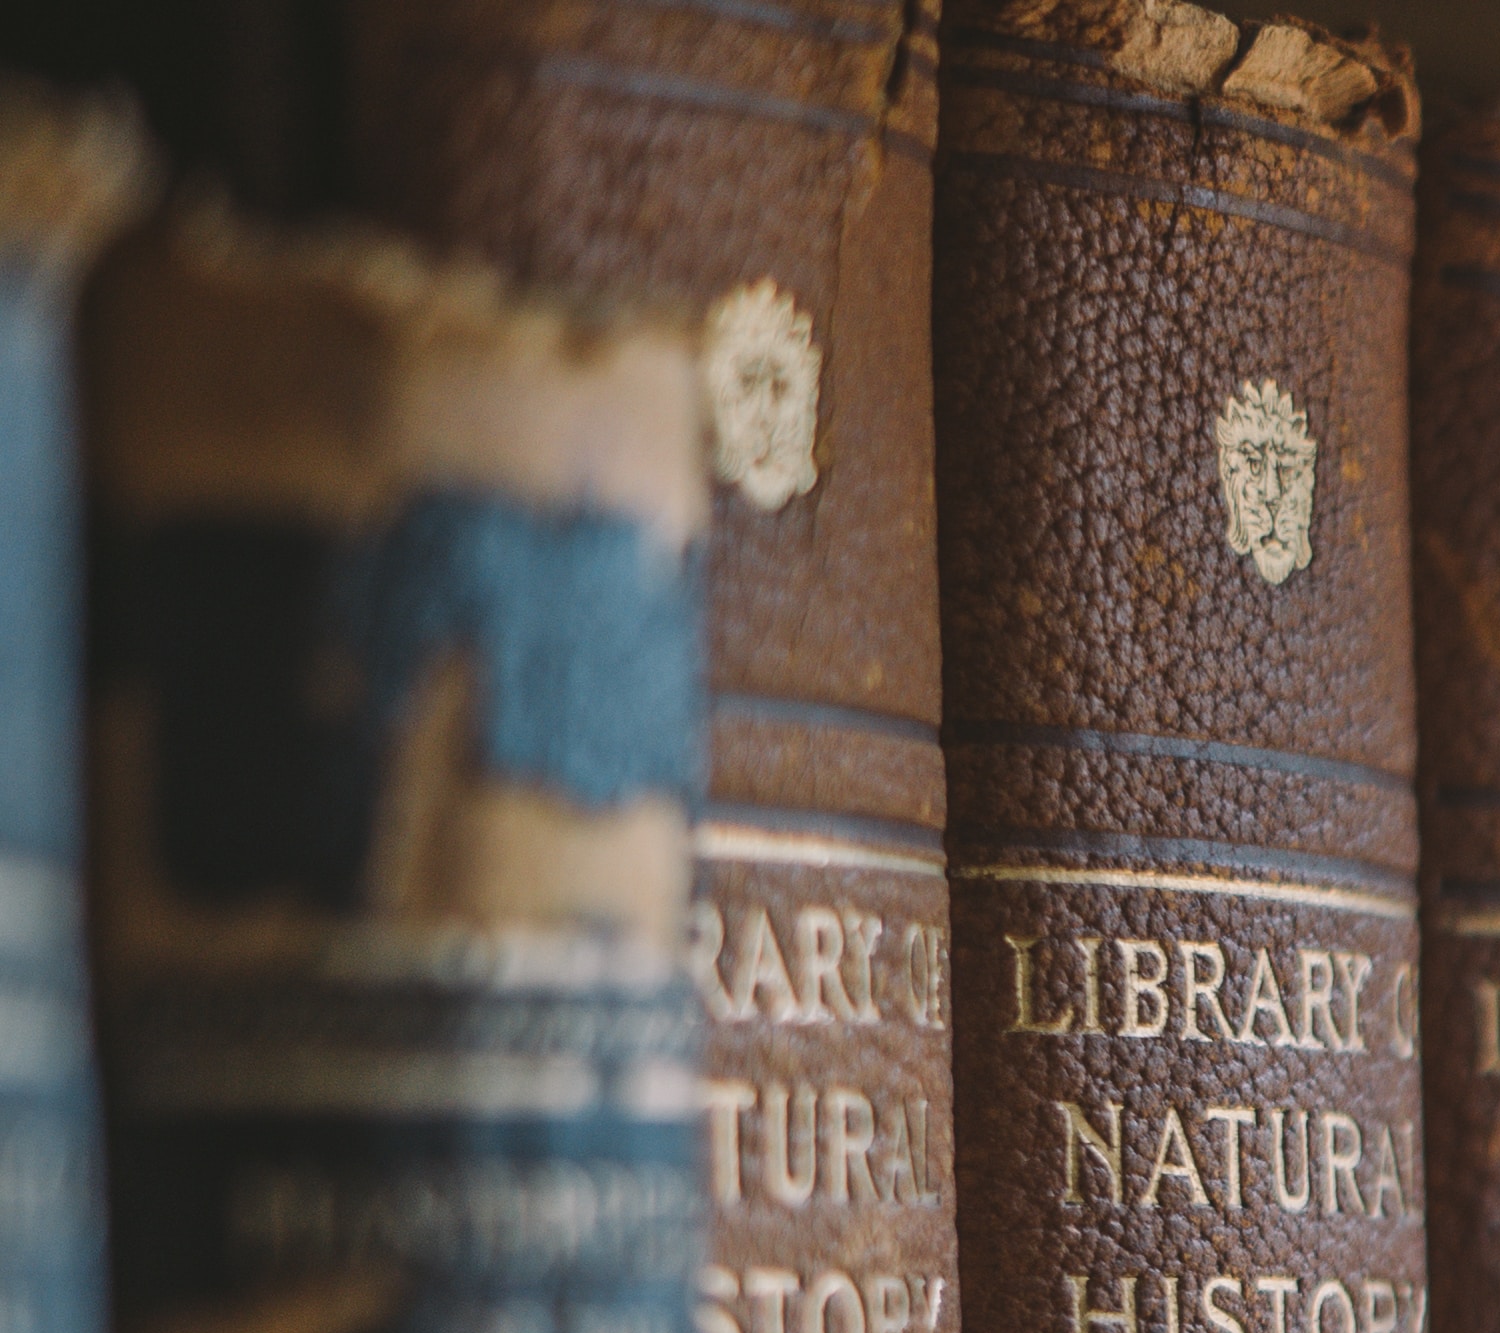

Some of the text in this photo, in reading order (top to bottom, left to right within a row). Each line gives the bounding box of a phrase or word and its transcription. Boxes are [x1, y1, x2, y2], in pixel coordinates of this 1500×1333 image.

[692, 898, 882, 1026] RARY
[1003, 934, 1372, 1055] LIBRARY
[702, 1076, 941, 1207] TURAL
